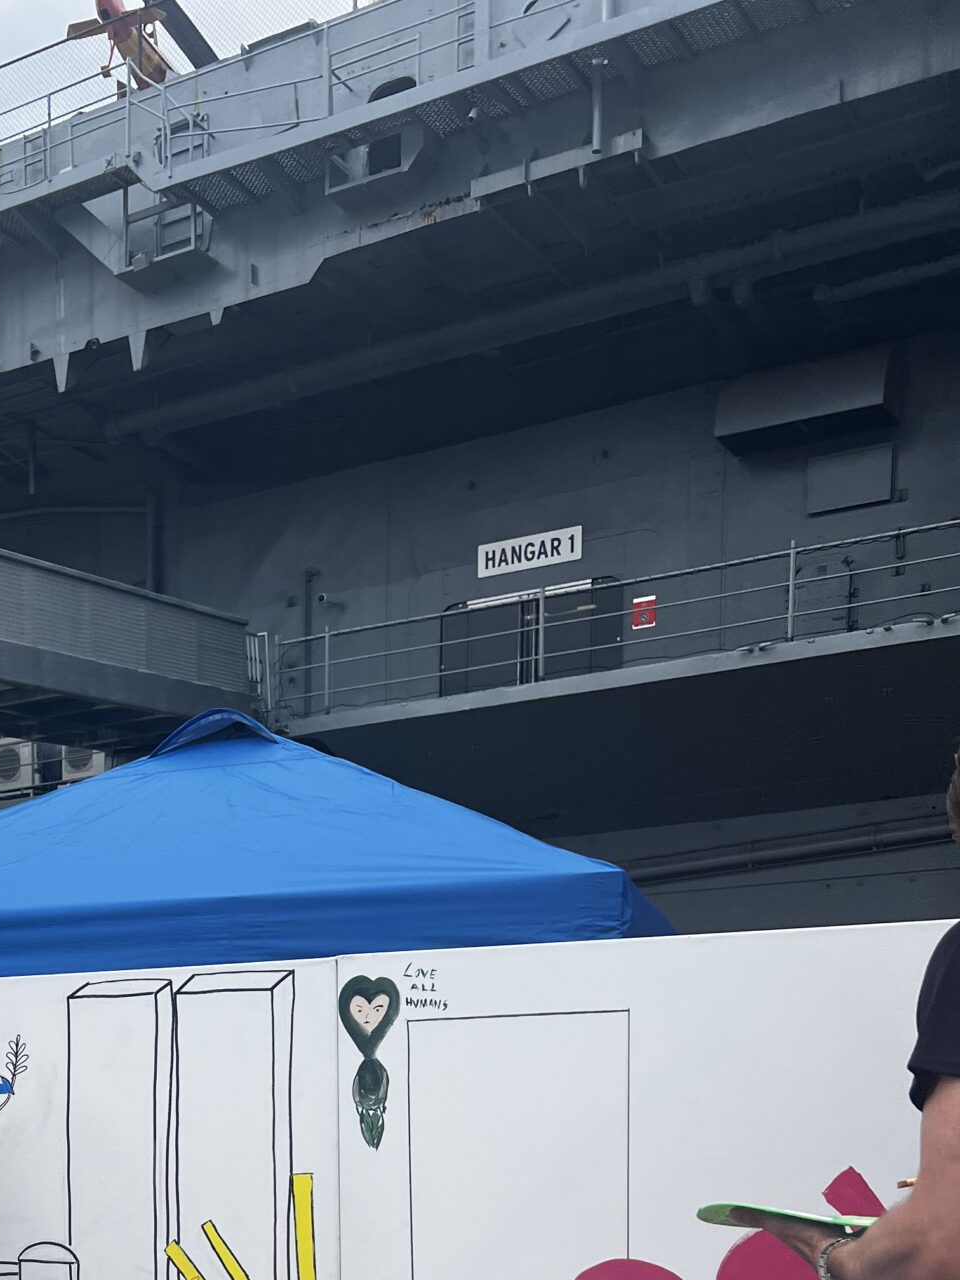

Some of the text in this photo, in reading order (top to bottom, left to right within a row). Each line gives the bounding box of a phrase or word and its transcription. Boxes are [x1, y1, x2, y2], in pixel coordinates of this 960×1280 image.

[484, 534, 575, 571] HANGAR 1
[403, 962, 438, 980] LOVE
[410, 983, 437, 992] ALL
[405, 996, 448, 1011] HUMANS
